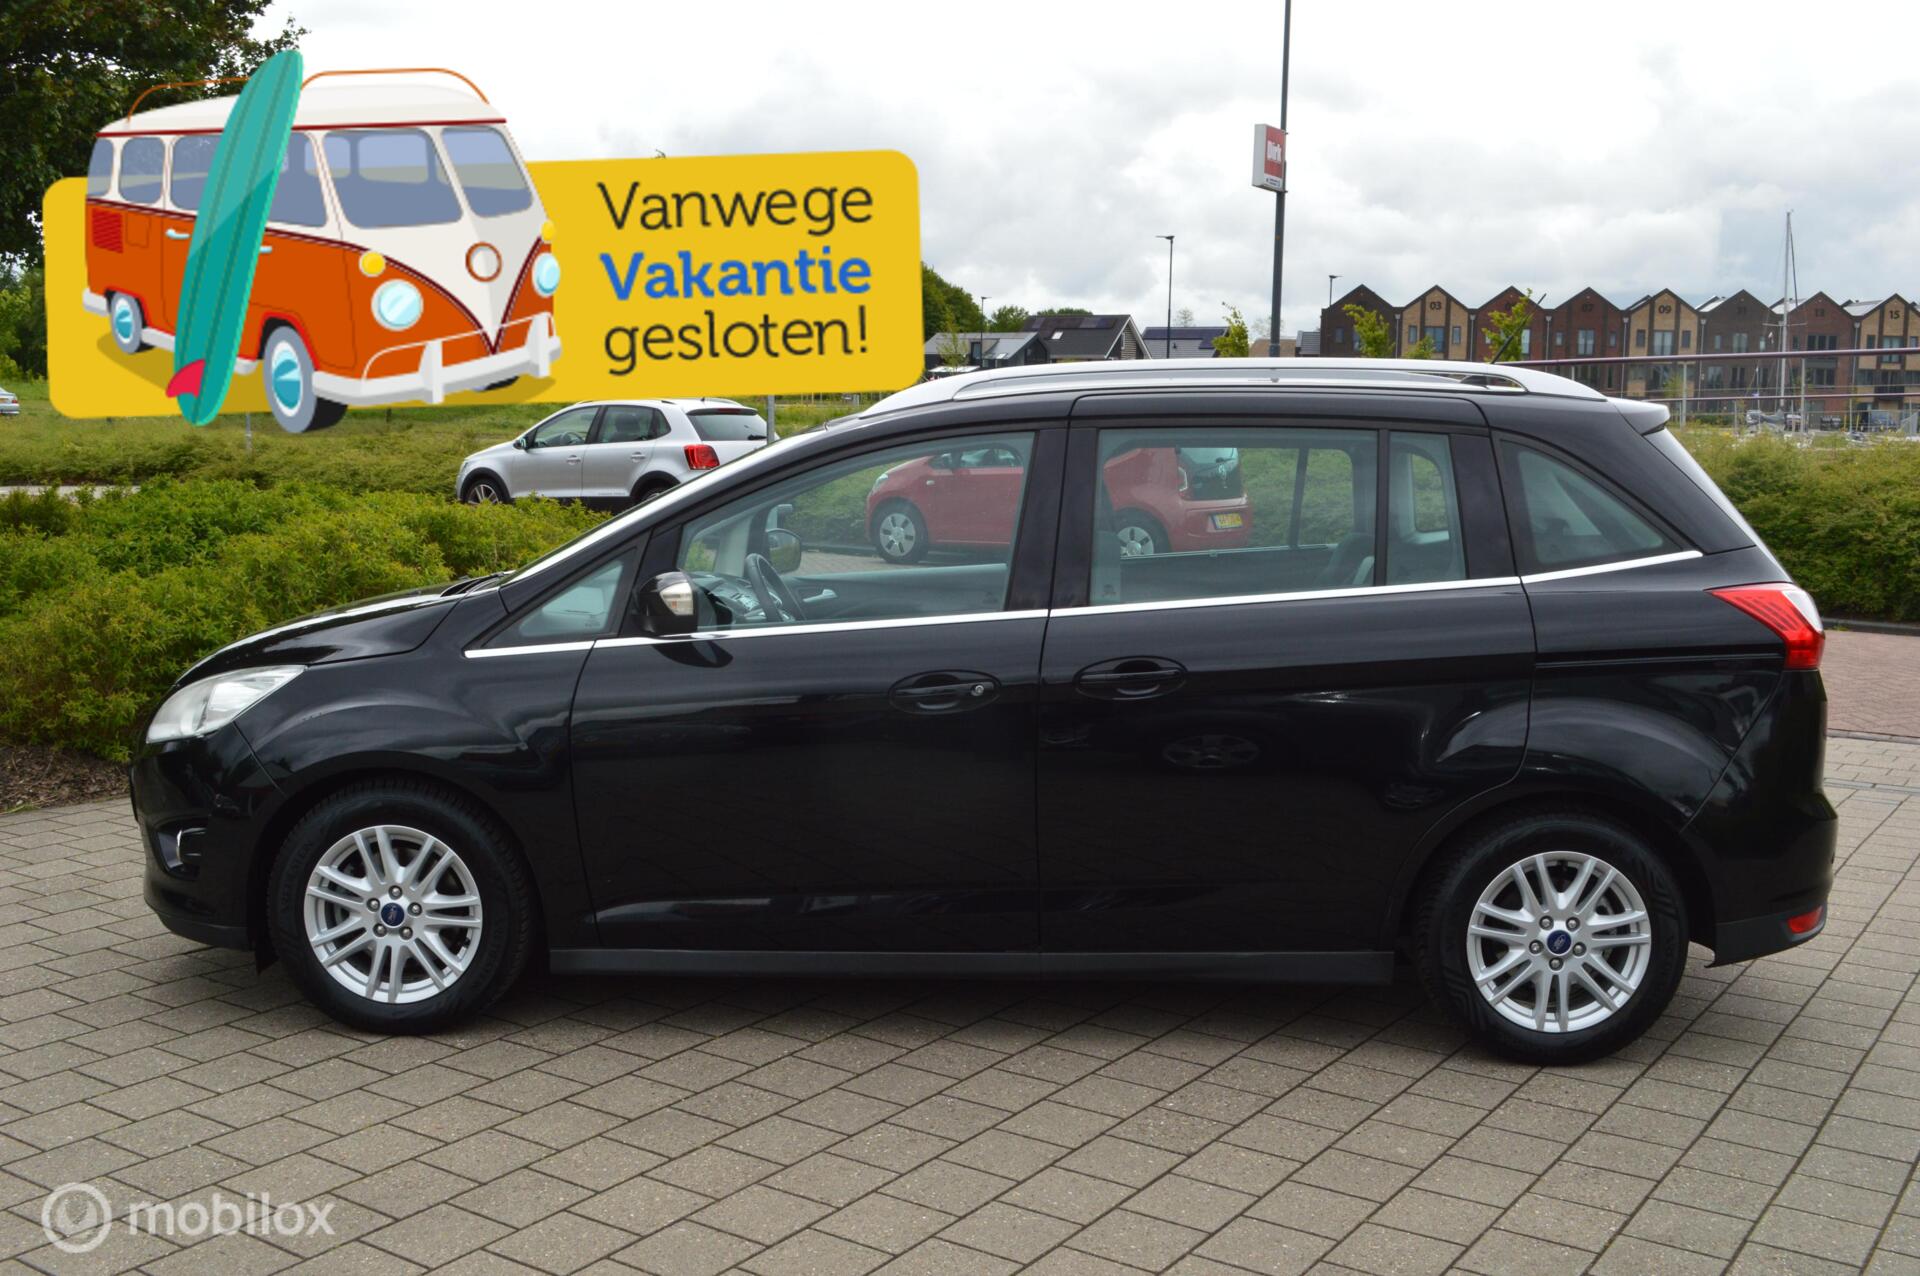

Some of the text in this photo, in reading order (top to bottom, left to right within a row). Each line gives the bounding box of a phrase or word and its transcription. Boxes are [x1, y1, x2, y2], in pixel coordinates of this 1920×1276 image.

[1430, 301, 1442, 310] 03
[1658, 304, 1671, 314] 09
[1889, 310, 1900, 319] 15
